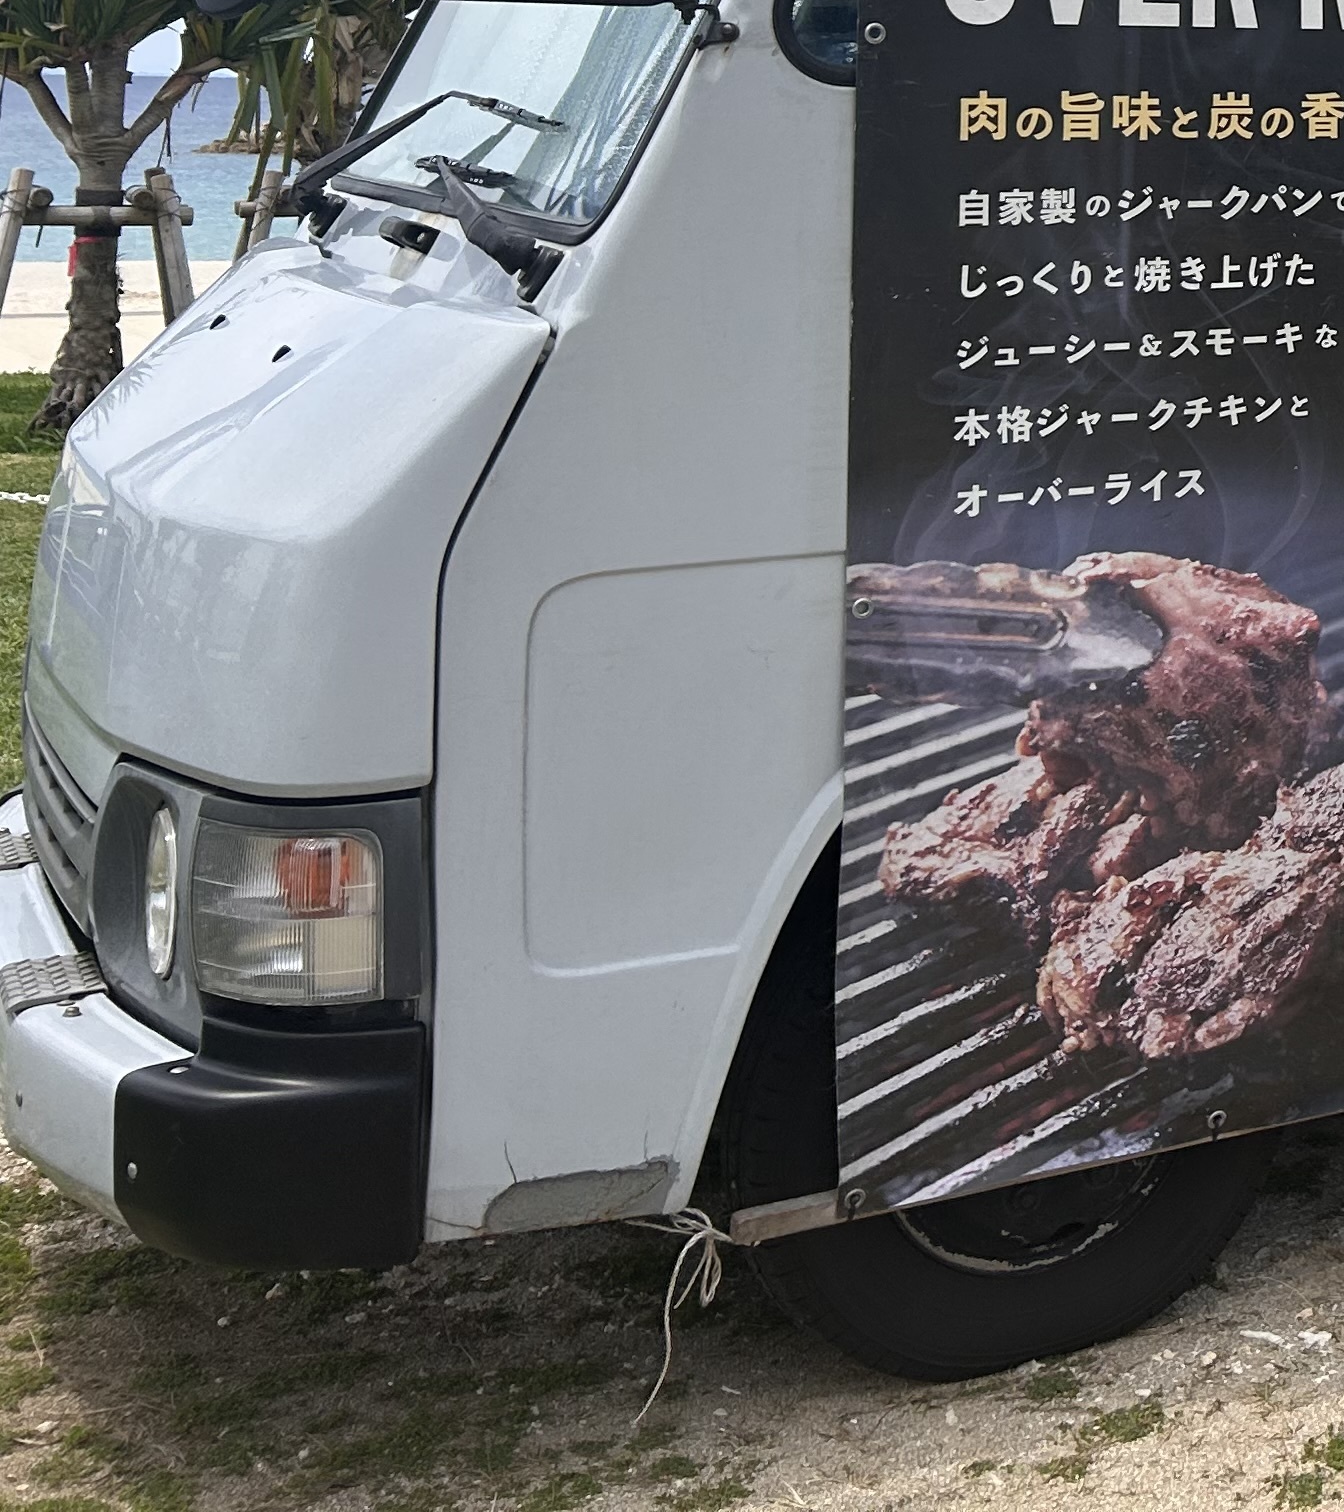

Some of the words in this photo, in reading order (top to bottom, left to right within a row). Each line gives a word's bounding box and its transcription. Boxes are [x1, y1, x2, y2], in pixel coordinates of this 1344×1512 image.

[959, 252, 1317, 300] じっくりと焼き上げた
[952, 391, 1311, 448] 本格ジャークチキンと
[953, 466, 1206, 519] オーバーライス
